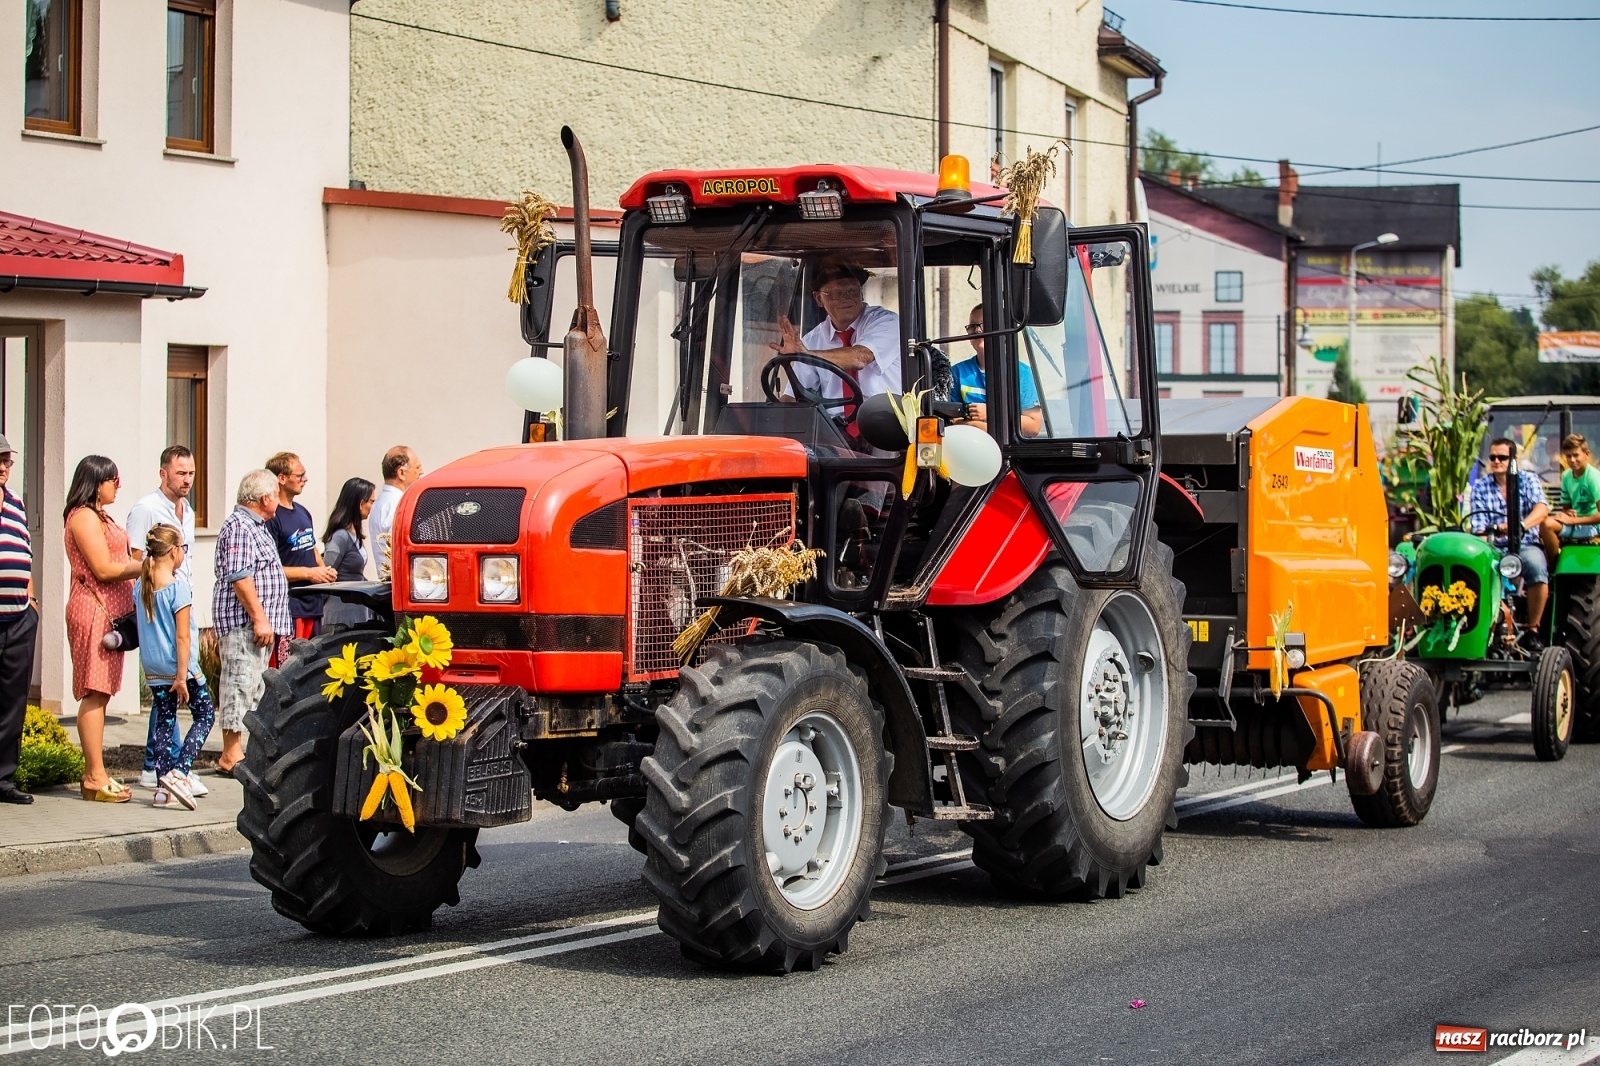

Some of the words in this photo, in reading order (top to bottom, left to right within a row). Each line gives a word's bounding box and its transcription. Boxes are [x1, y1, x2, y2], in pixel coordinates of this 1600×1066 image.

[703, 178, 780, 195] AGROPOL
[1155, 283, 1202, 294] WIELKIE
[1296, 451, 1333, 470] Warfama
[1272, 473, 1289, 489] Z-543
[468, 760, 511, 779] BELARUS
